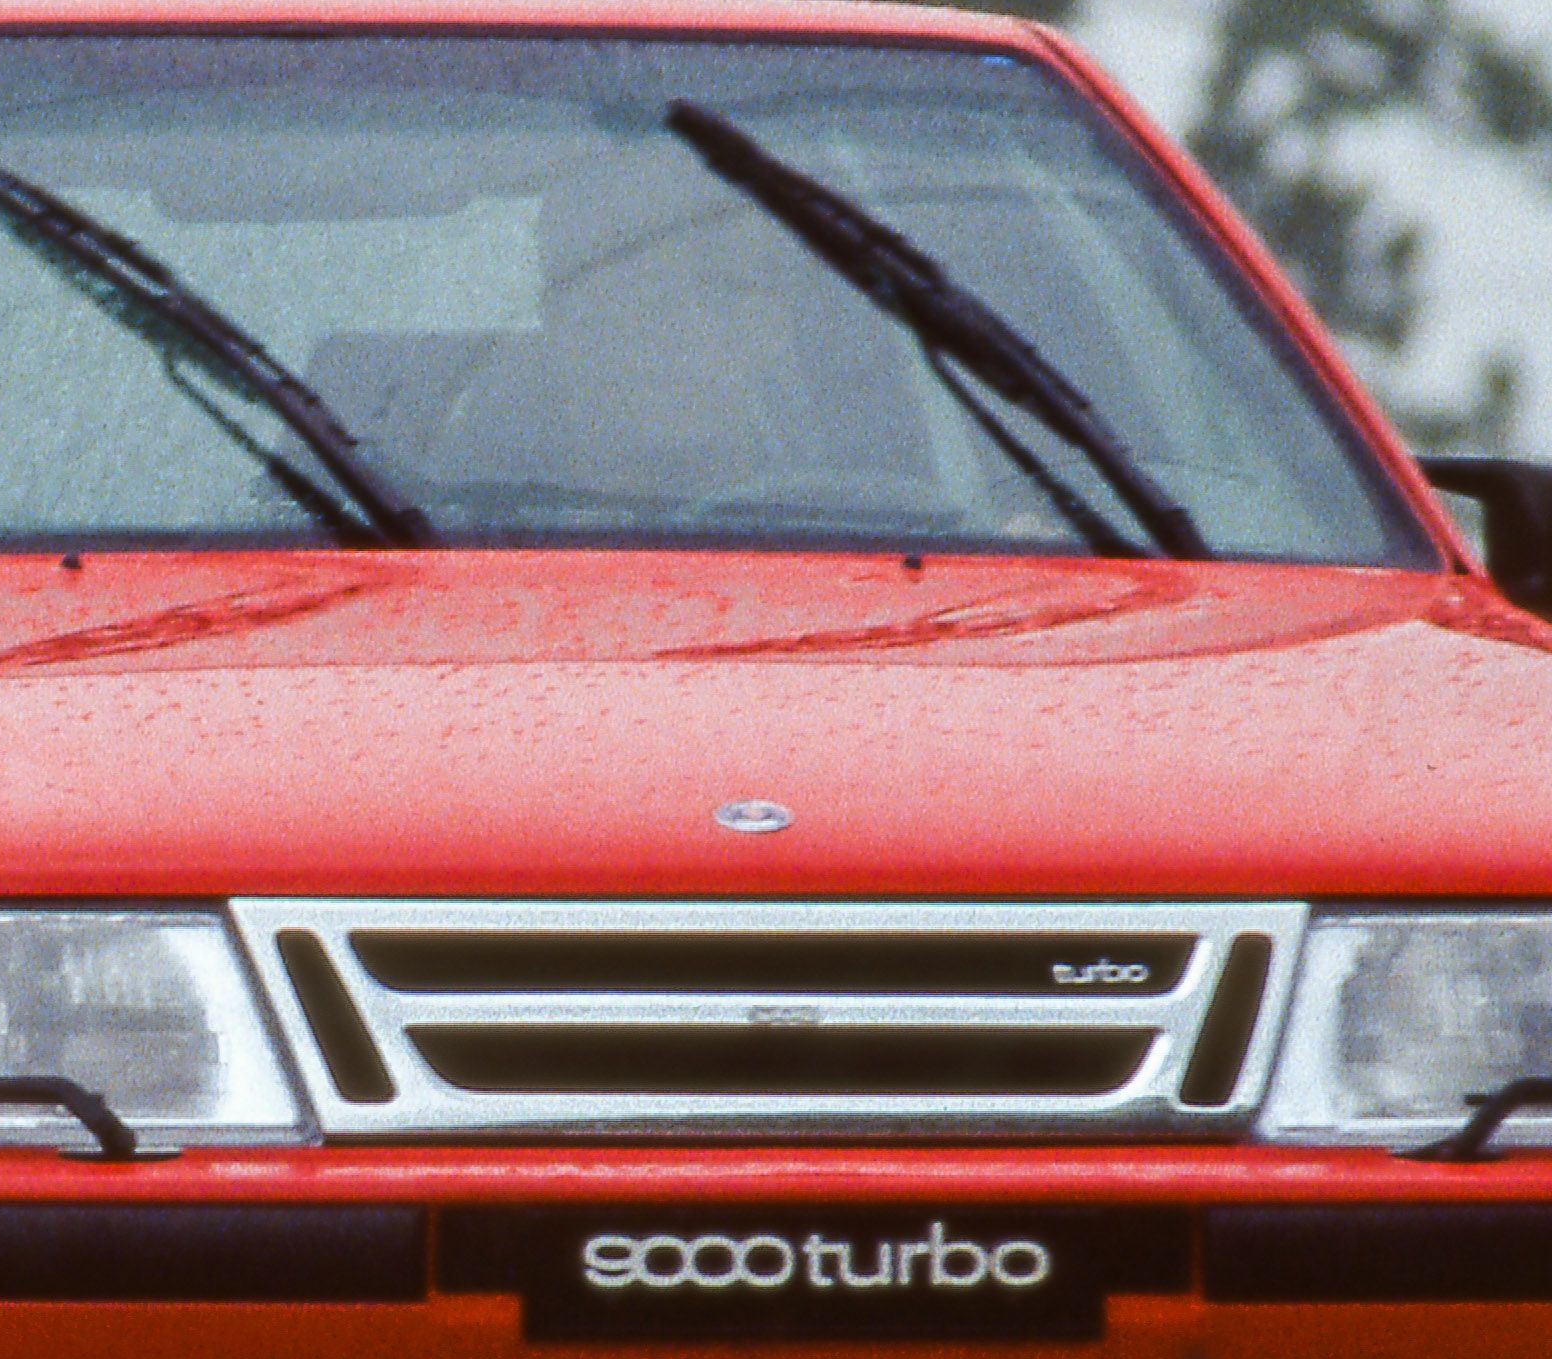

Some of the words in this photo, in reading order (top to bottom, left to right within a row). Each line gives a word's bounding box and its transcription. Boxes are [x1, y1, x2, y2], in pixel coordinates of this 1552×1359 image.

[1052, 958, 1149, 984] turbo
[583, 1235, 794, 1288] 9000
[802, 1220, 1051, 1287] turbo
